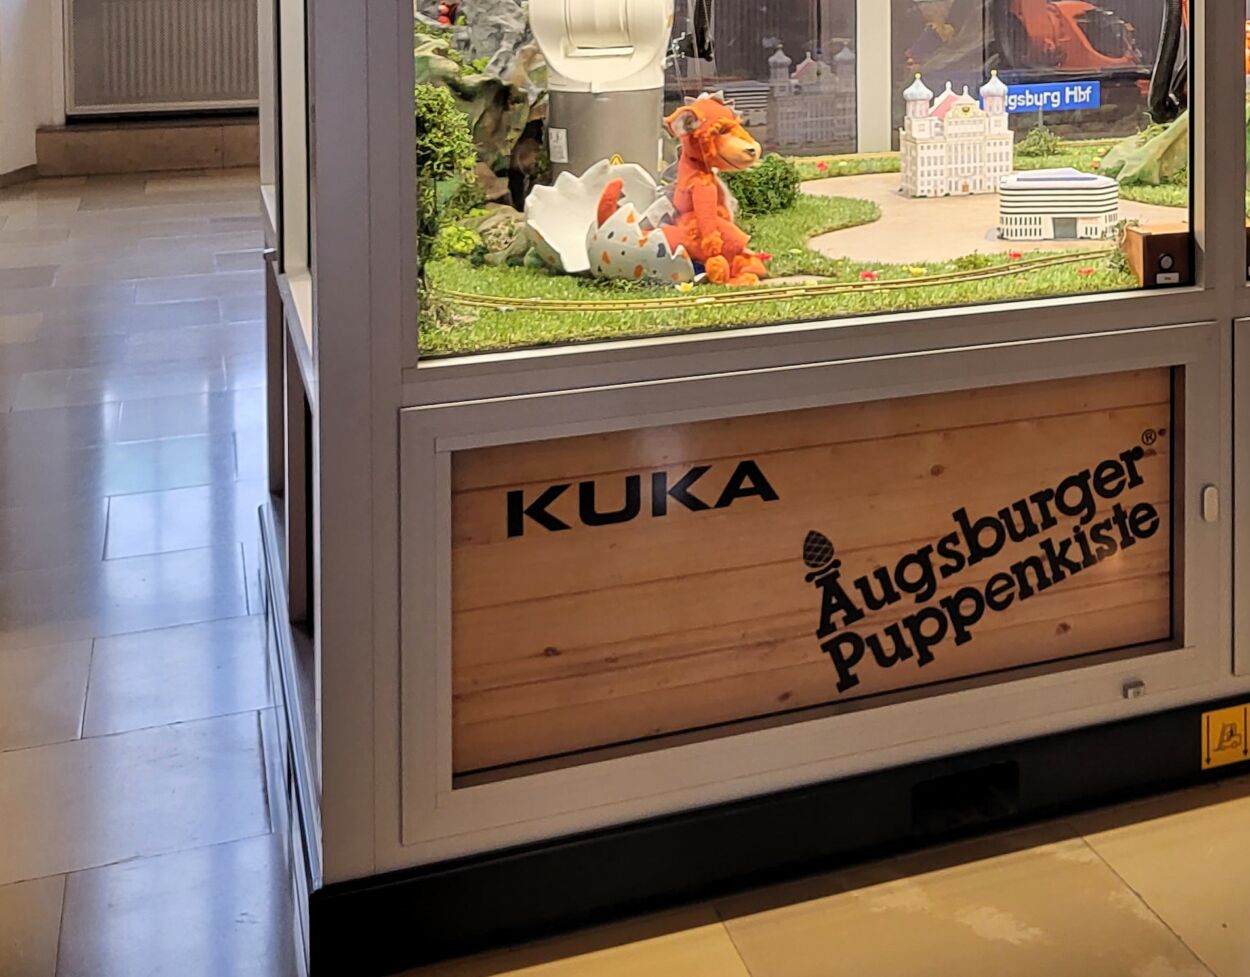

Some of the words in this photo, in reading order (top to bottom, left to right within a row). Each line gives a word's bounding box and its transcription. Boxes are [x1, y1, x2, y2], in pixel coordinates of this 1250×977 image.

[1005, 89, 1061, 111] gsburg
[1065, 85, 1092, 104] Hbf
[820, 502, 1160, 693] Puppenkiste
